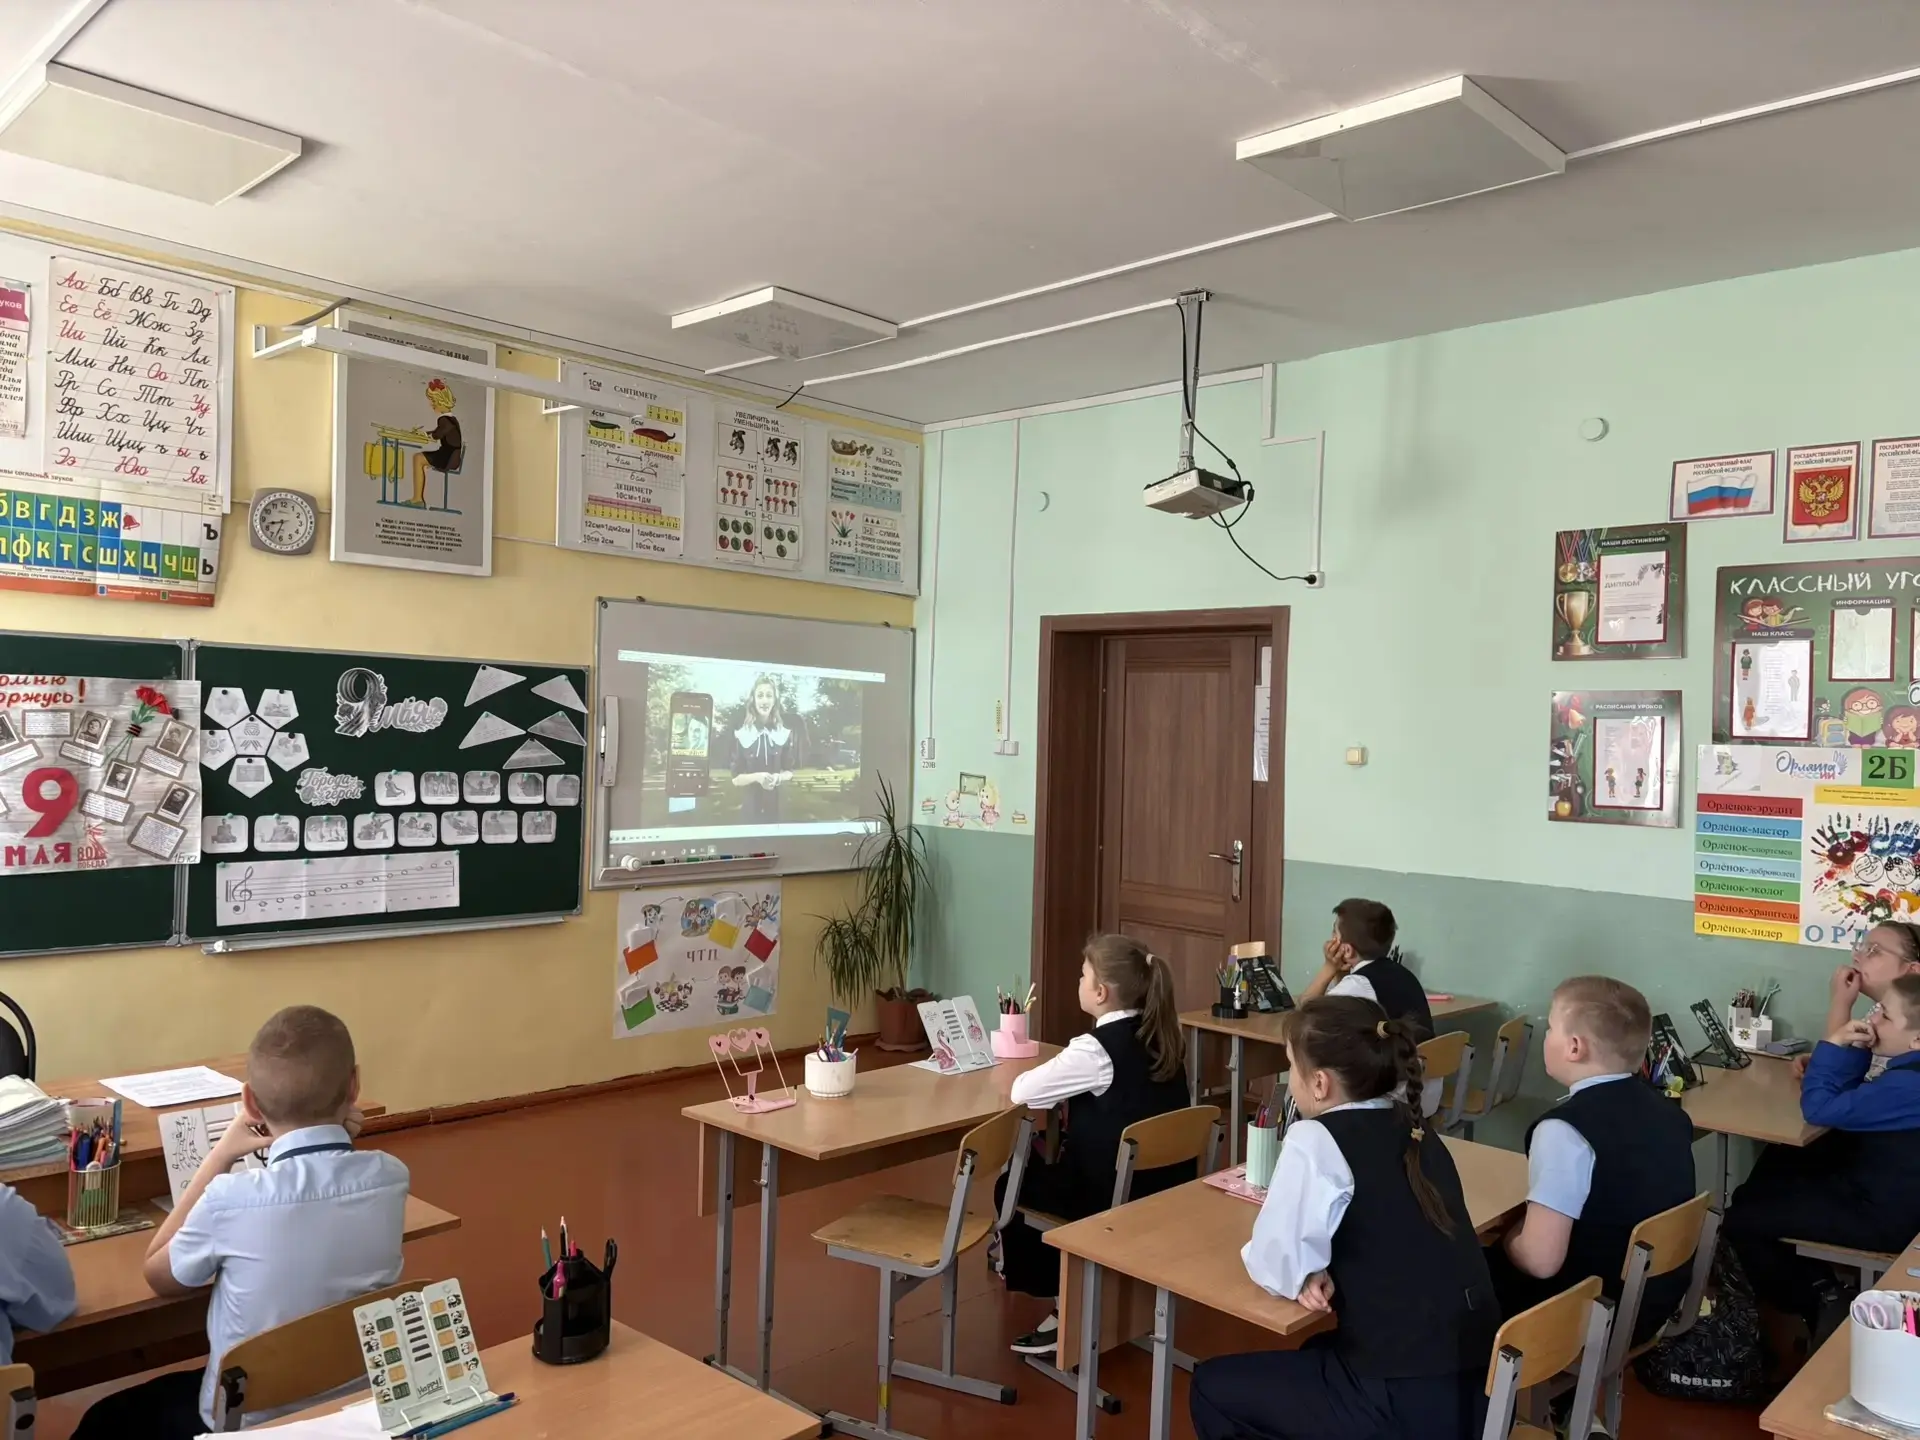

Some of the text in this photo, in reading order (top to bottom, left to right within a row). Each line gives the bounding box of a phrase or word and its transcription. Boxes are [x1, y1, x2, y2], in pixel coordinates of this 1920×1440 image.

[56, 271, 212, 323] Аа Бб Вв Гг Дд
[59, 295, 204, 344] Ее Ёё Жж Зз
[59, 320, 211, 365] Ии Йй Кк Лл
[55, 347, 209, 389] Мм Нн Оо Пп
[54, 370, 211, 418] Рр Сс Тт Уу
[56, 396, 206, 437] Фф Хх Цц Чч
[734, 418, 771, 431] УМЕНЬШИТЬ
[735, 411, 770, 425] УВЕЛИЧИТЬ
[56, 420, 208, 460] Шш Щщ ъ ы ь
[55, 447, 208, 485] Ээ Юю Яя
[1621, 536, 1666, 545] ДОСТИЖЕНИЯ
[1604, 580, 1640, 588] ДИПЛОМ
[1730, 572, 1872, 594] КЛАССНЫЙ
[1836, 598, 1891, 606] ИНФОРМАЦИЯ
[1776, 750, 1836, 775] Орлята
[1868, 755, 1907, 780] 2Б
[302, 768, 350, 790] Города
[22, 767, 79, 838] 9
[4, 842, 72, 866] МАЯ
[78, 846, 93, 860] 80
[1805, 924, 1867, 946] ОРЛ
[417, 1377, 444, 1397] Happy!
[1670, 1373, 1732, 1387] ROBLOX
